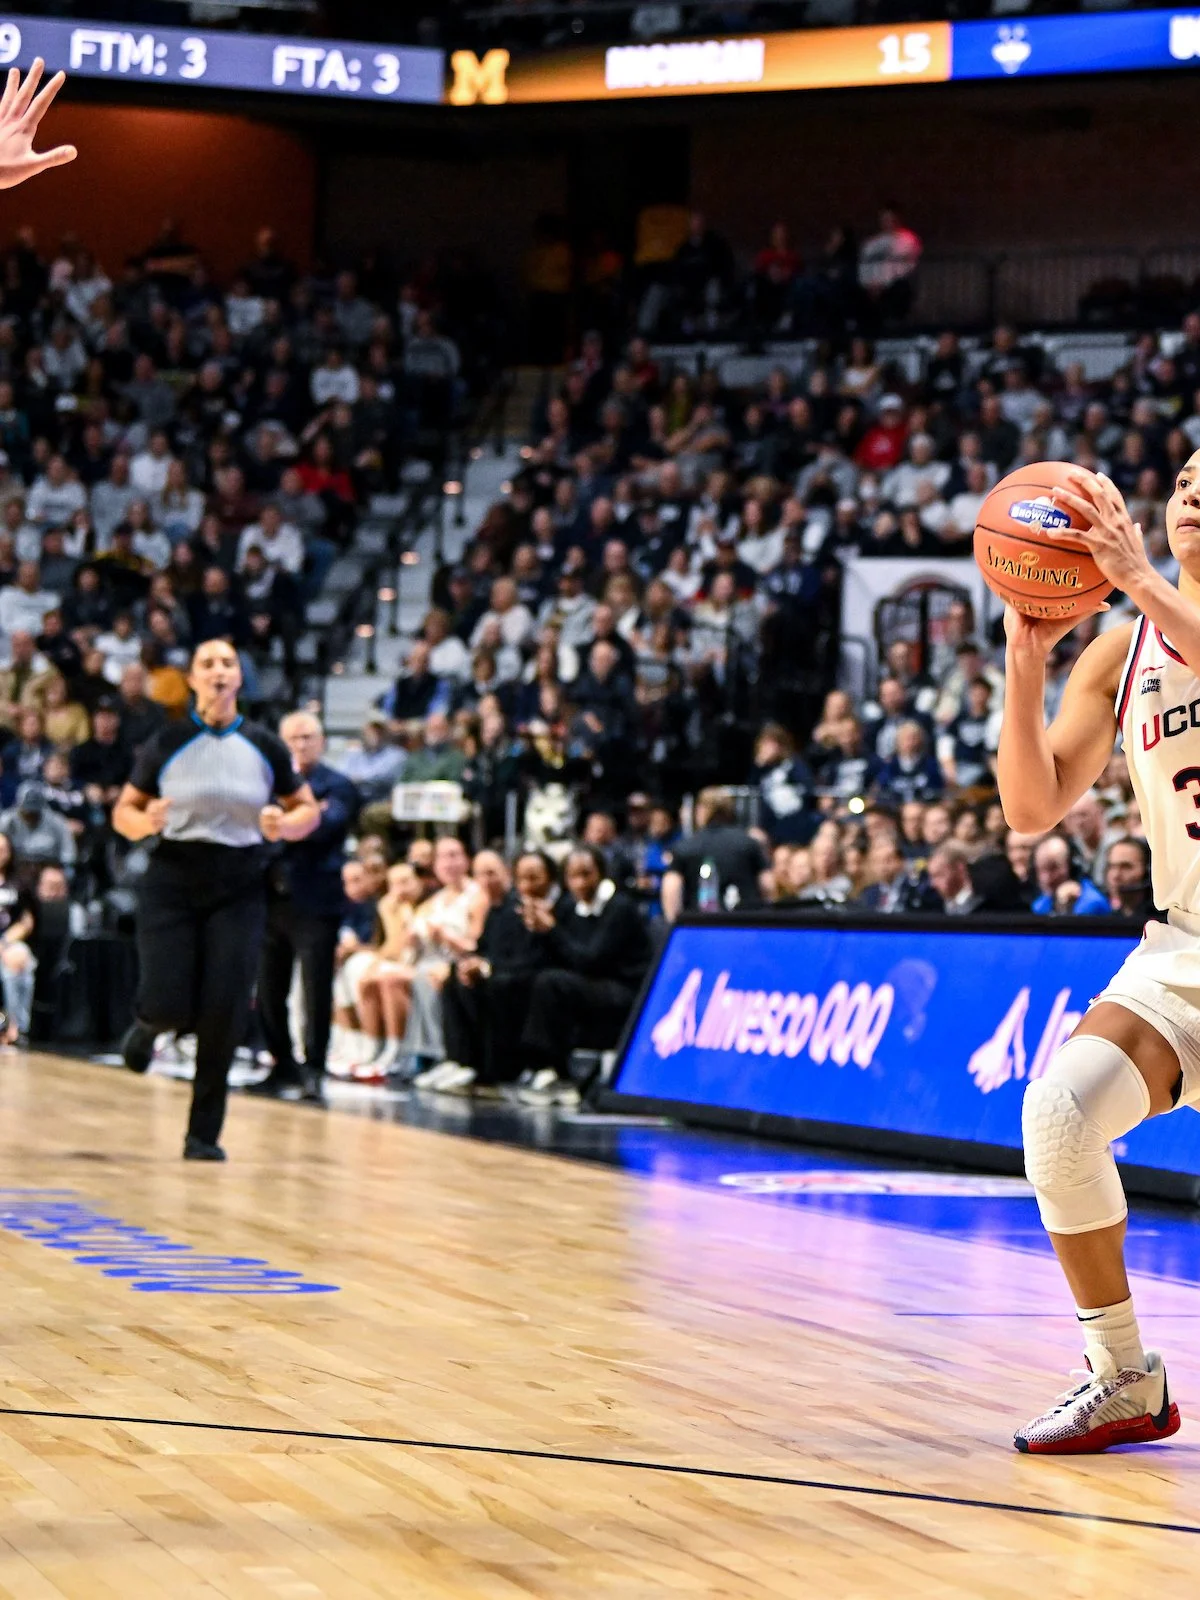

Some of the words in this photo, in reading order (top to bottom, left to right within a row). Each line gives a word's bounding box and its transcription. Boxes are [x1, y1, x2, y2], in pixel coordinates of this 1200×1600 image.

[70, 28, 168, 76] FTM:
[179, 37, 207, 79] 3
[272, 45, 361, 92] FTA:
[372, 53, 401, 95] 3
[450, 49, 510, 106] M
[877, 34, 932, 74] 15
[988, 546, 1081, 589] SPALDING
[695, 970, 819, 1058] Invesco
